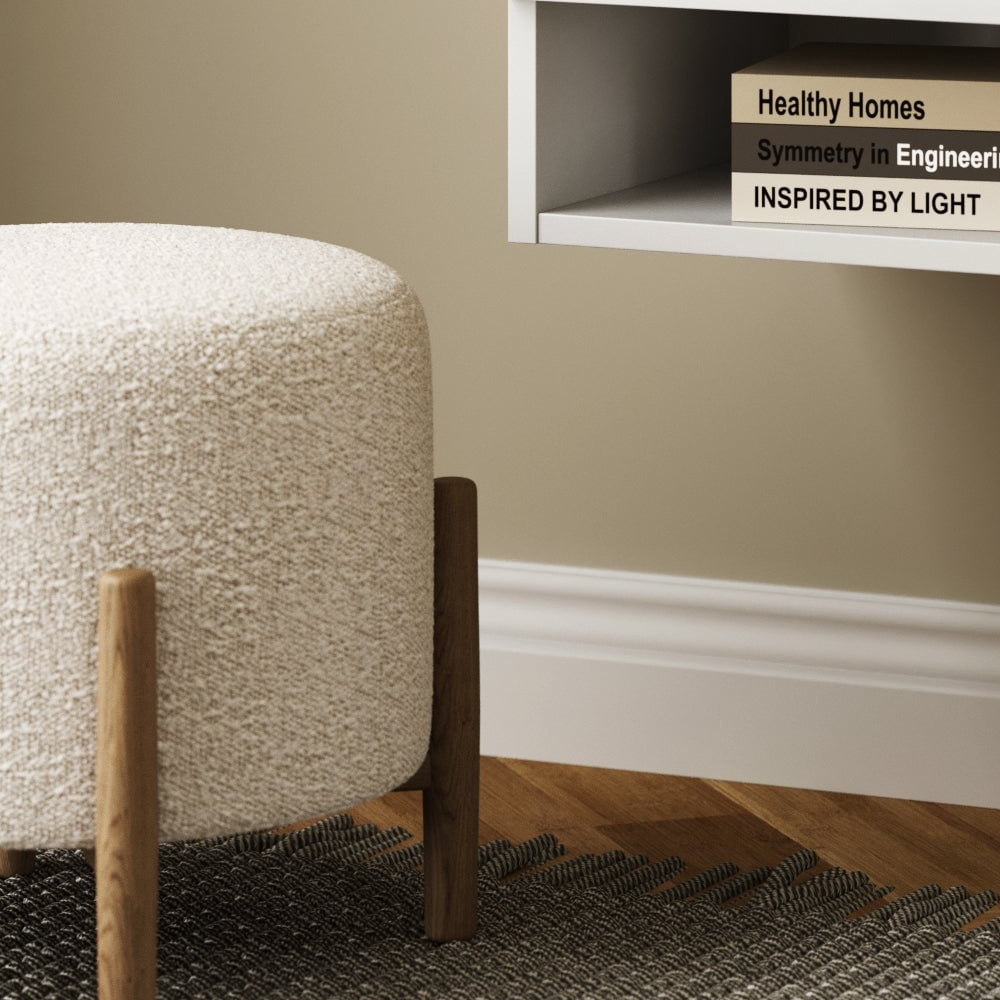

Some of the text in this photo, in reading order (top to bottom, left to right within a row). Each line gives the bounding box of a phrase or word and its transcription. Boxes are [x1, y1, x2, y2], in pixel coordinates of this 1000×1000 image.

[757, 88, 925, 123] Healthy Homes
[757, 139, 864, 169] Symmetry
[870, 143, 889, 164] in
[754, 186, 981, 215] INSPIRED BY LIGHT
